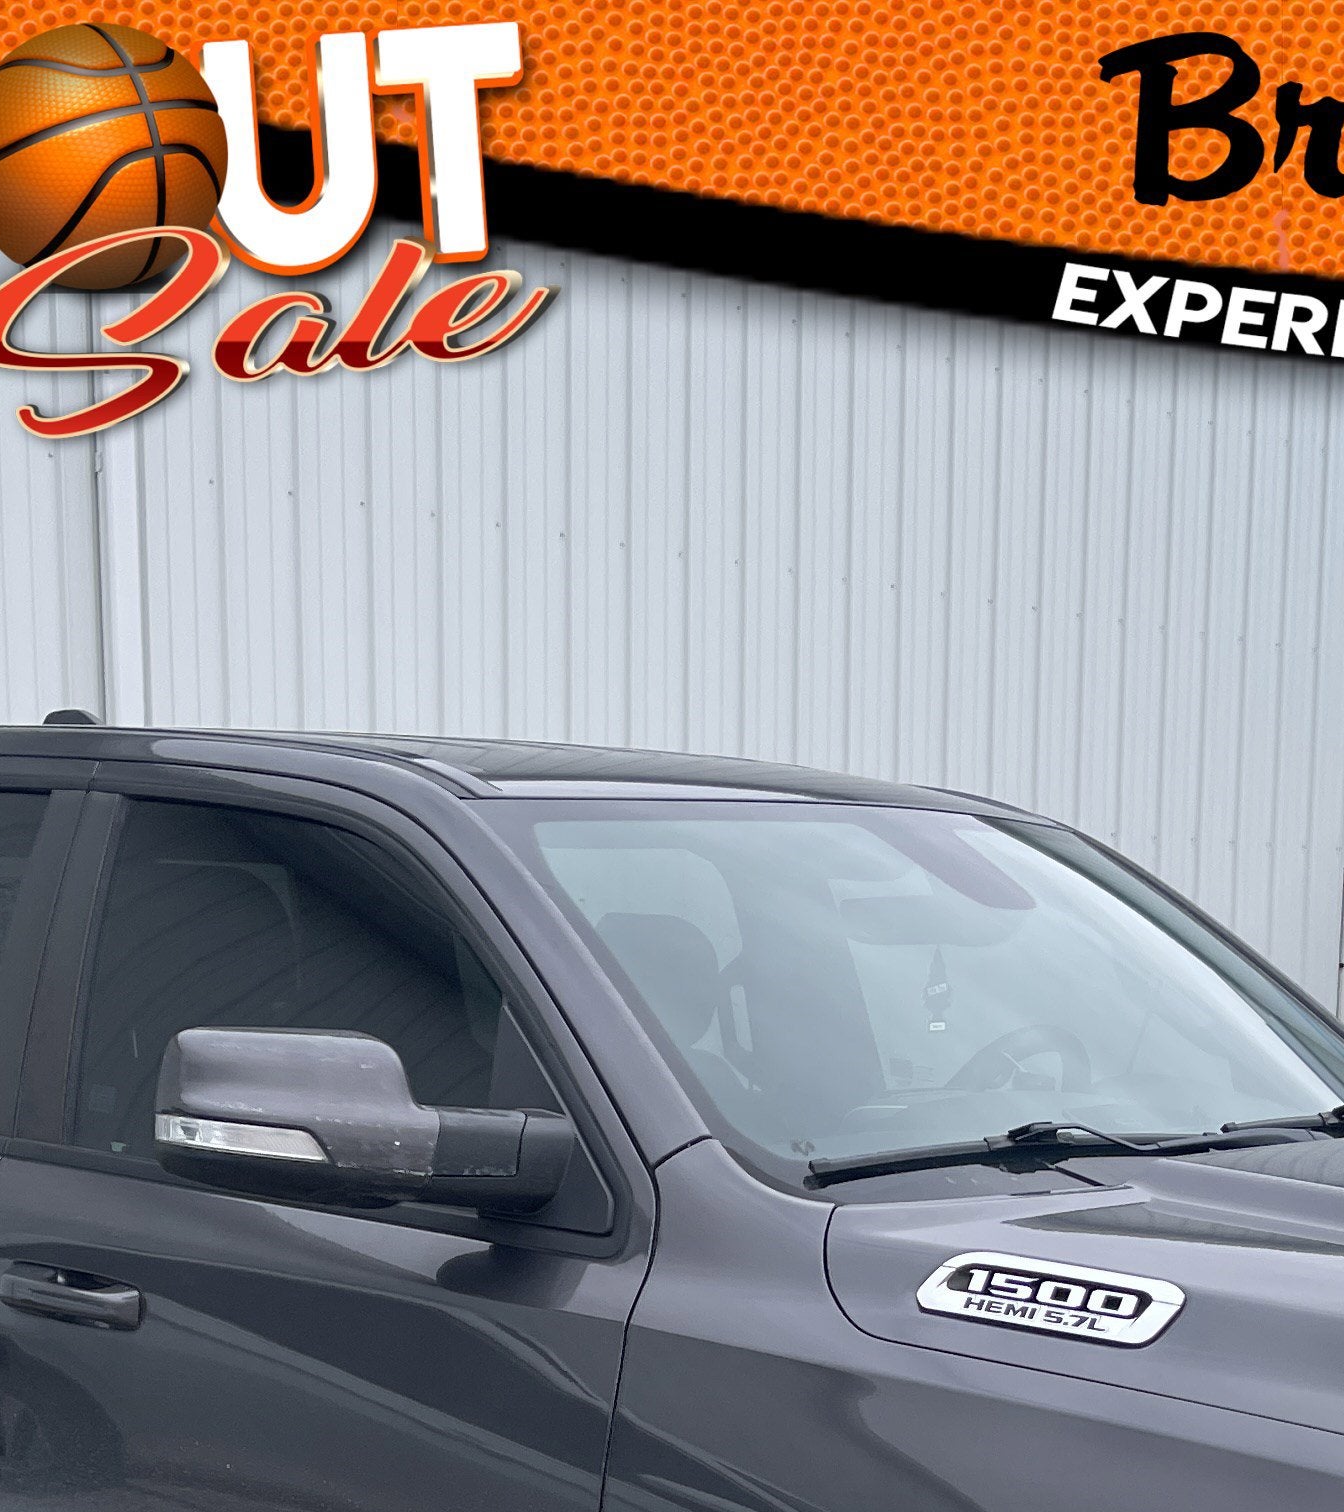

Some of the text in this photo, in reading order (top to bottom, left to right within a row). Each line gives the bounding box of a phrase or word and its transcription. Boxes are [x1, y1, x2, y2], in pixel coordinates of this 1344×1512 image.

[967, 1268, 1141, 1317] 1500
[963, 1297, 1106, 1332] HEMI 5.7L
